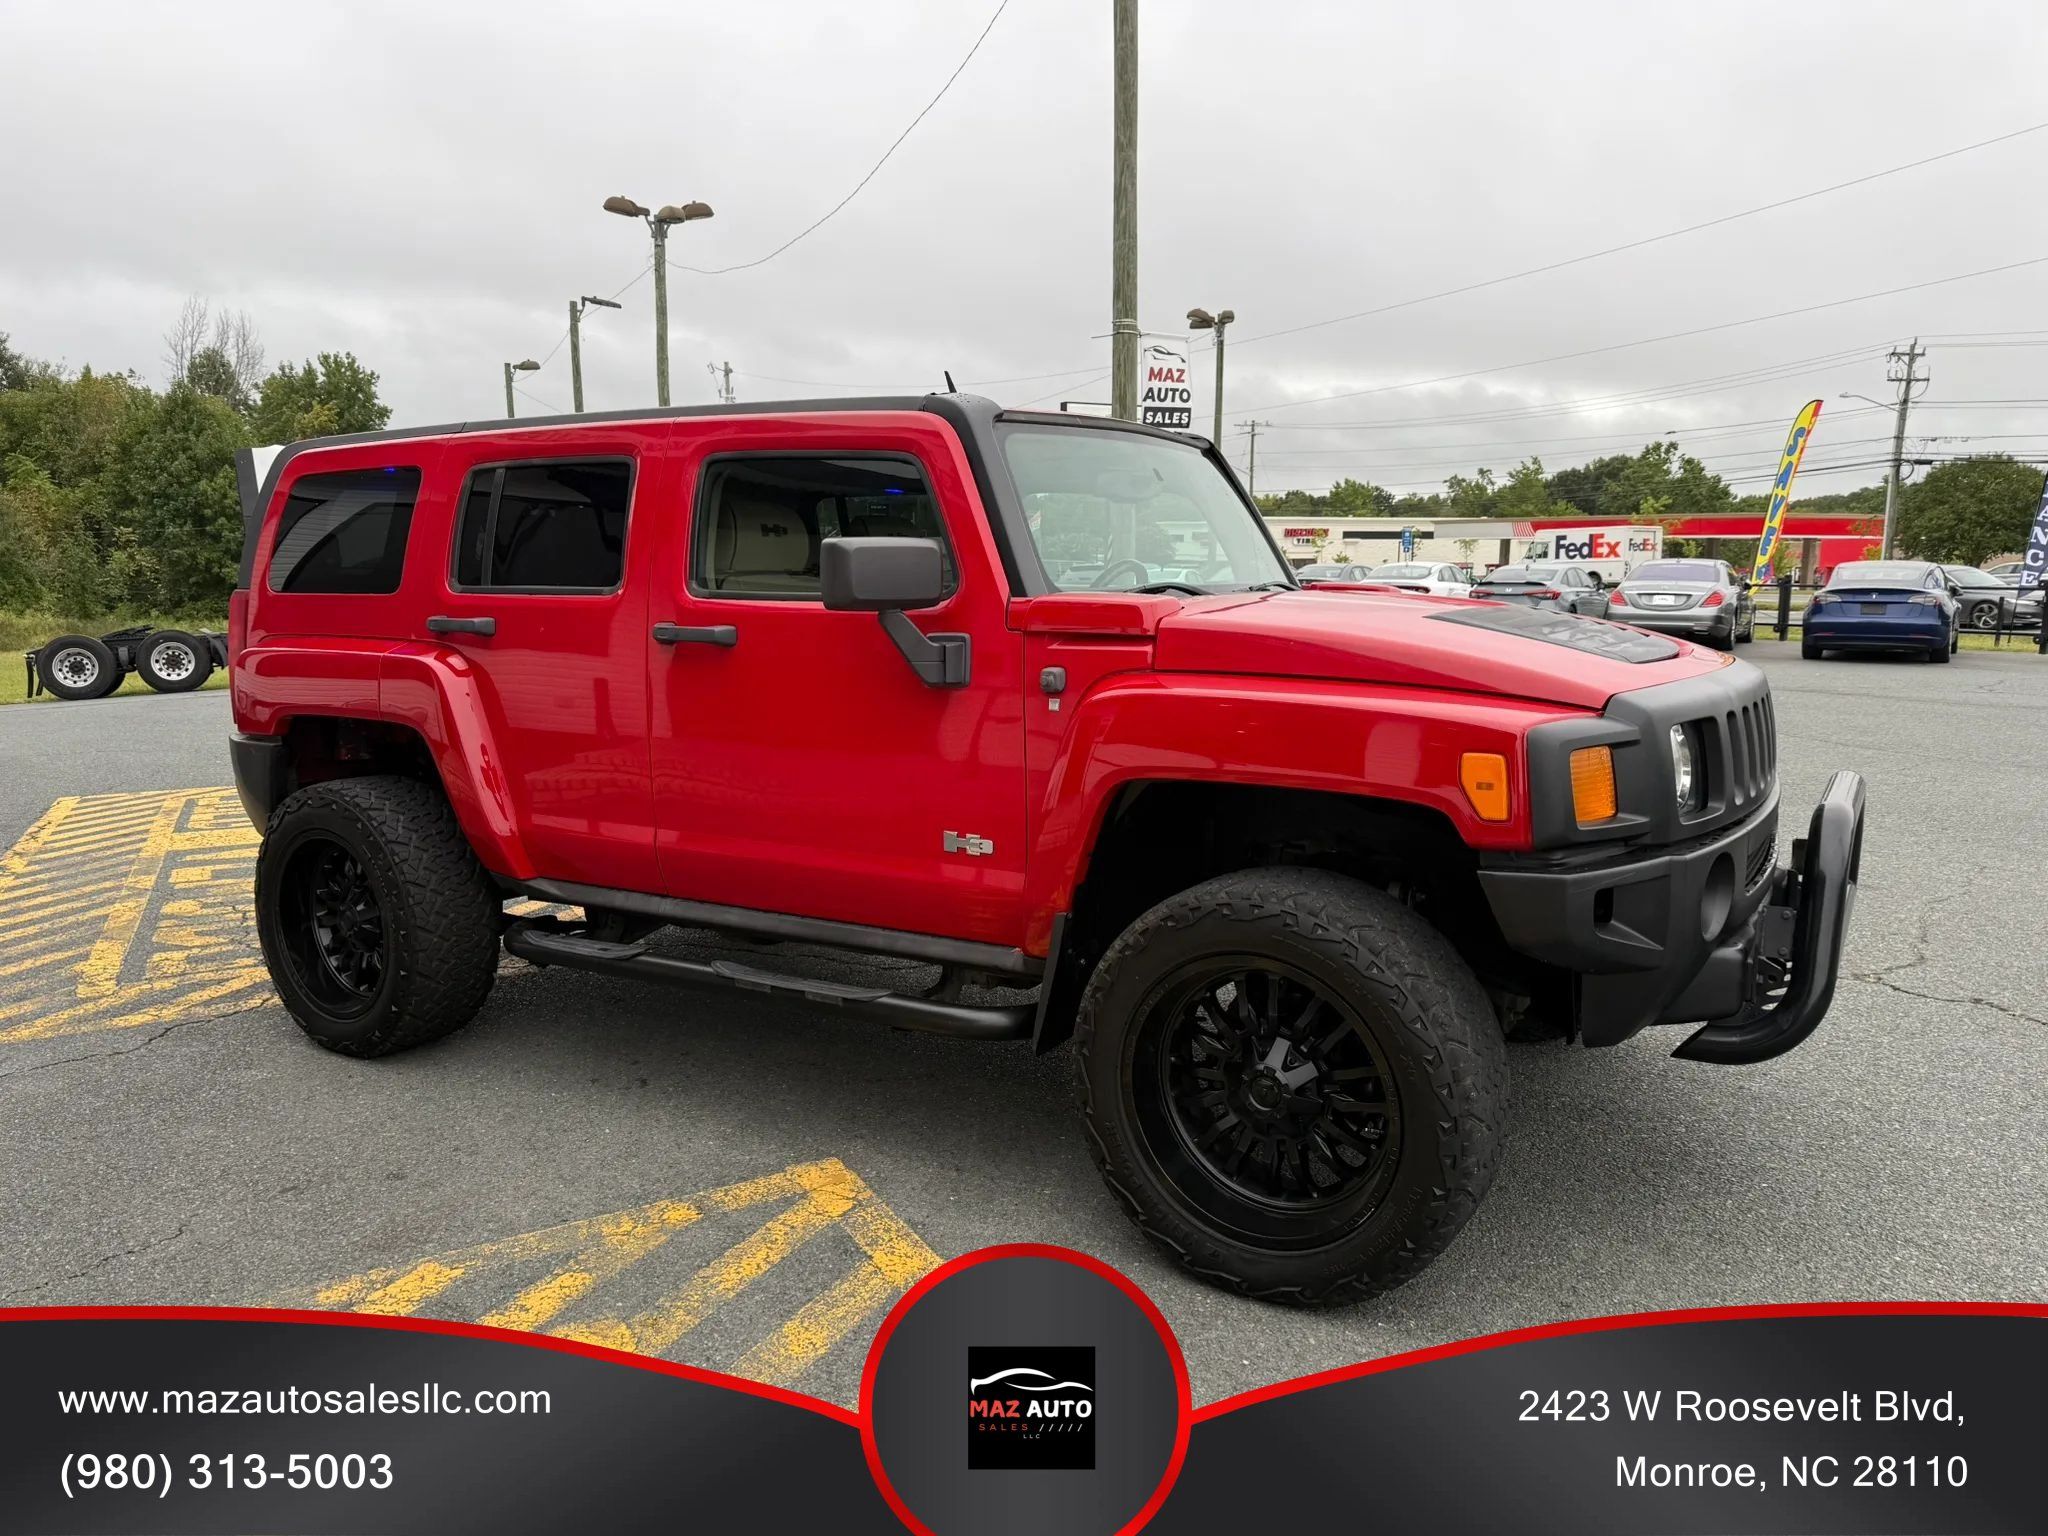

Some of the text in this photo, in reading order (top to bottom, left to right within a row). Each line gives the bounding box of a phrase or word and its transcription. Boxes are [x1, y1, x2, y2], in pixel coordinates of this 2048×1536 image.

[1148, 366, 1186, 383] MAZ
[1142, 387, 1191, 404] AUTO
[1145, 411, 1189, 424] SALES
[1760, 426, 1807, 556] SAVE
[1555, 533, 1621, 559] FedEx
[1628, 538, 1657, 552] FedEx
[943, 830, 994, 855] H3
